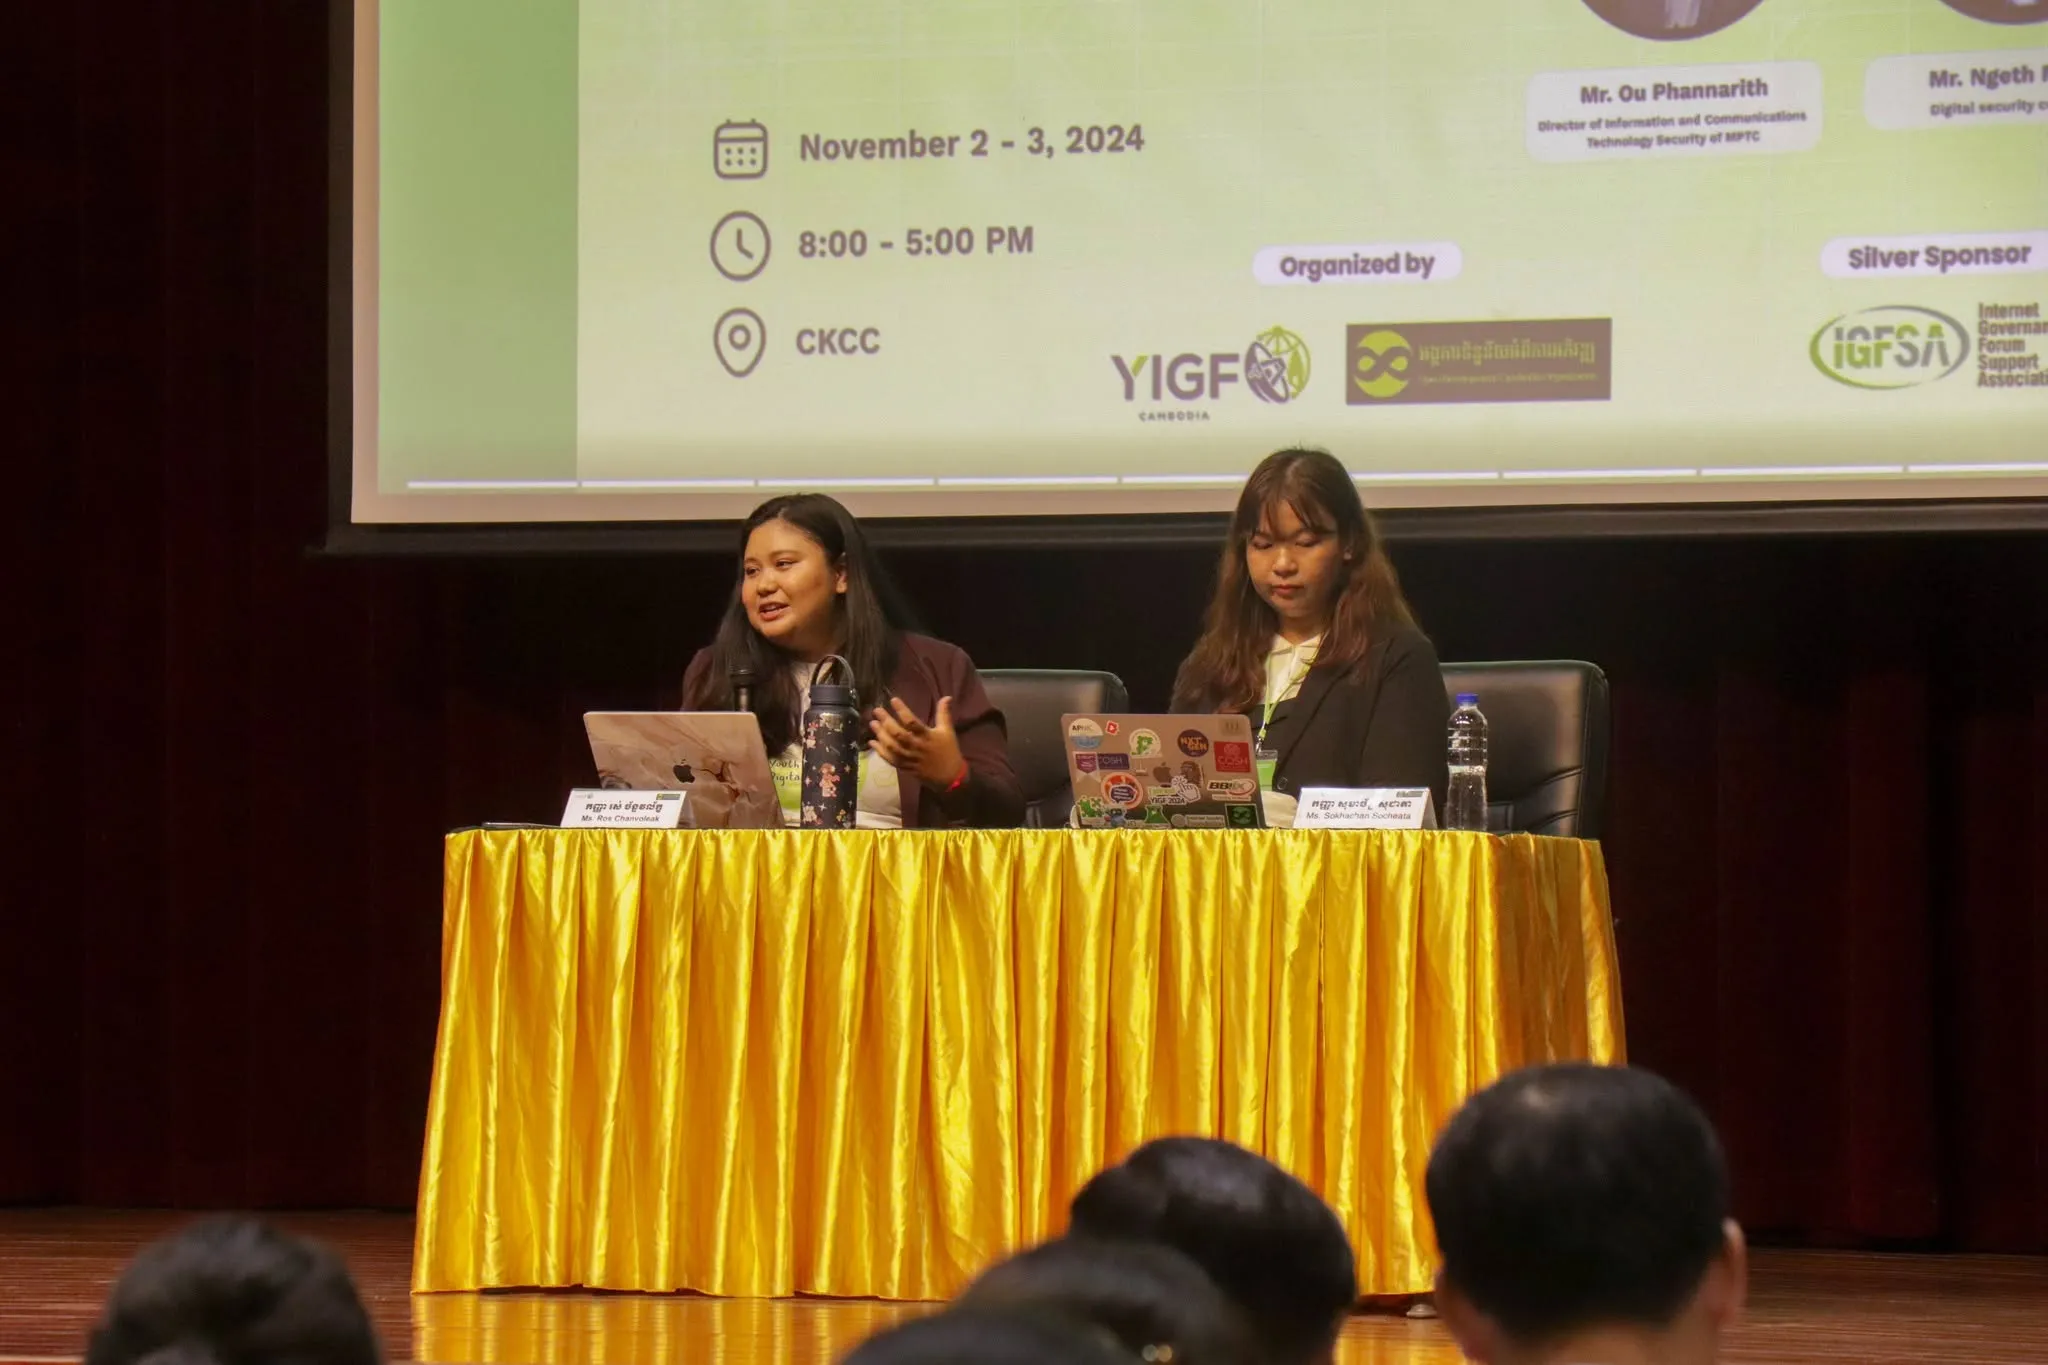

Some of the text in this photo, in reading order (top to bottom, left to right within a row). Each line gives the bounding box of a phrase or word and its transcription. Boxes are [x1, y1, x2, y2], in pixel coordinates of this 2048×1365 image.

[1930, 69, 1963, 88] Mr.
[1971, 64, 2034, 90] Ngeth
[1580, 78, 1768, 104] Mr. Ou Phannarith
[1930, 102, 1975, 119] Digital
[1979, 99, 2034, 115] security
[1538, 111, 1806, 132] Director of Information and Communications
[800, 129, 960, 160] November
[969, 130, 989, 157] 2
[1027, 127, 1054, 158] 3,
[1066, 124, 1145, 153] 2024
[1588, 131, 1760, 149] Technology Security of MPTC
[799, 230, 868, 257] 8:00
[906, 228, 974, 255] 5:00
[986, 227, 1034, 254] PM
[1280, 251, 1436, 283] Organized by
[1849, 245, 2032, 273] Silver Sponsor
[1979, 302, 2039, 319] Internet
[796, 328, 881, 355] CKCC
[1832, 323, 1950, 369] IGFSA
[1979, 337, 2026, 353] Forum
[1978, 353, 2038, 372] Support
[1111, 353, 1240, 402] YIGF
[1139, 410, 1210, 422] CAMBODIA
[769, 760, 800, 769] Youth
[597, 814, 612, 822] Ros
[614, 814, 660, 823] Chanvoleak
[1372, 811, 1412, 820] Socheata
